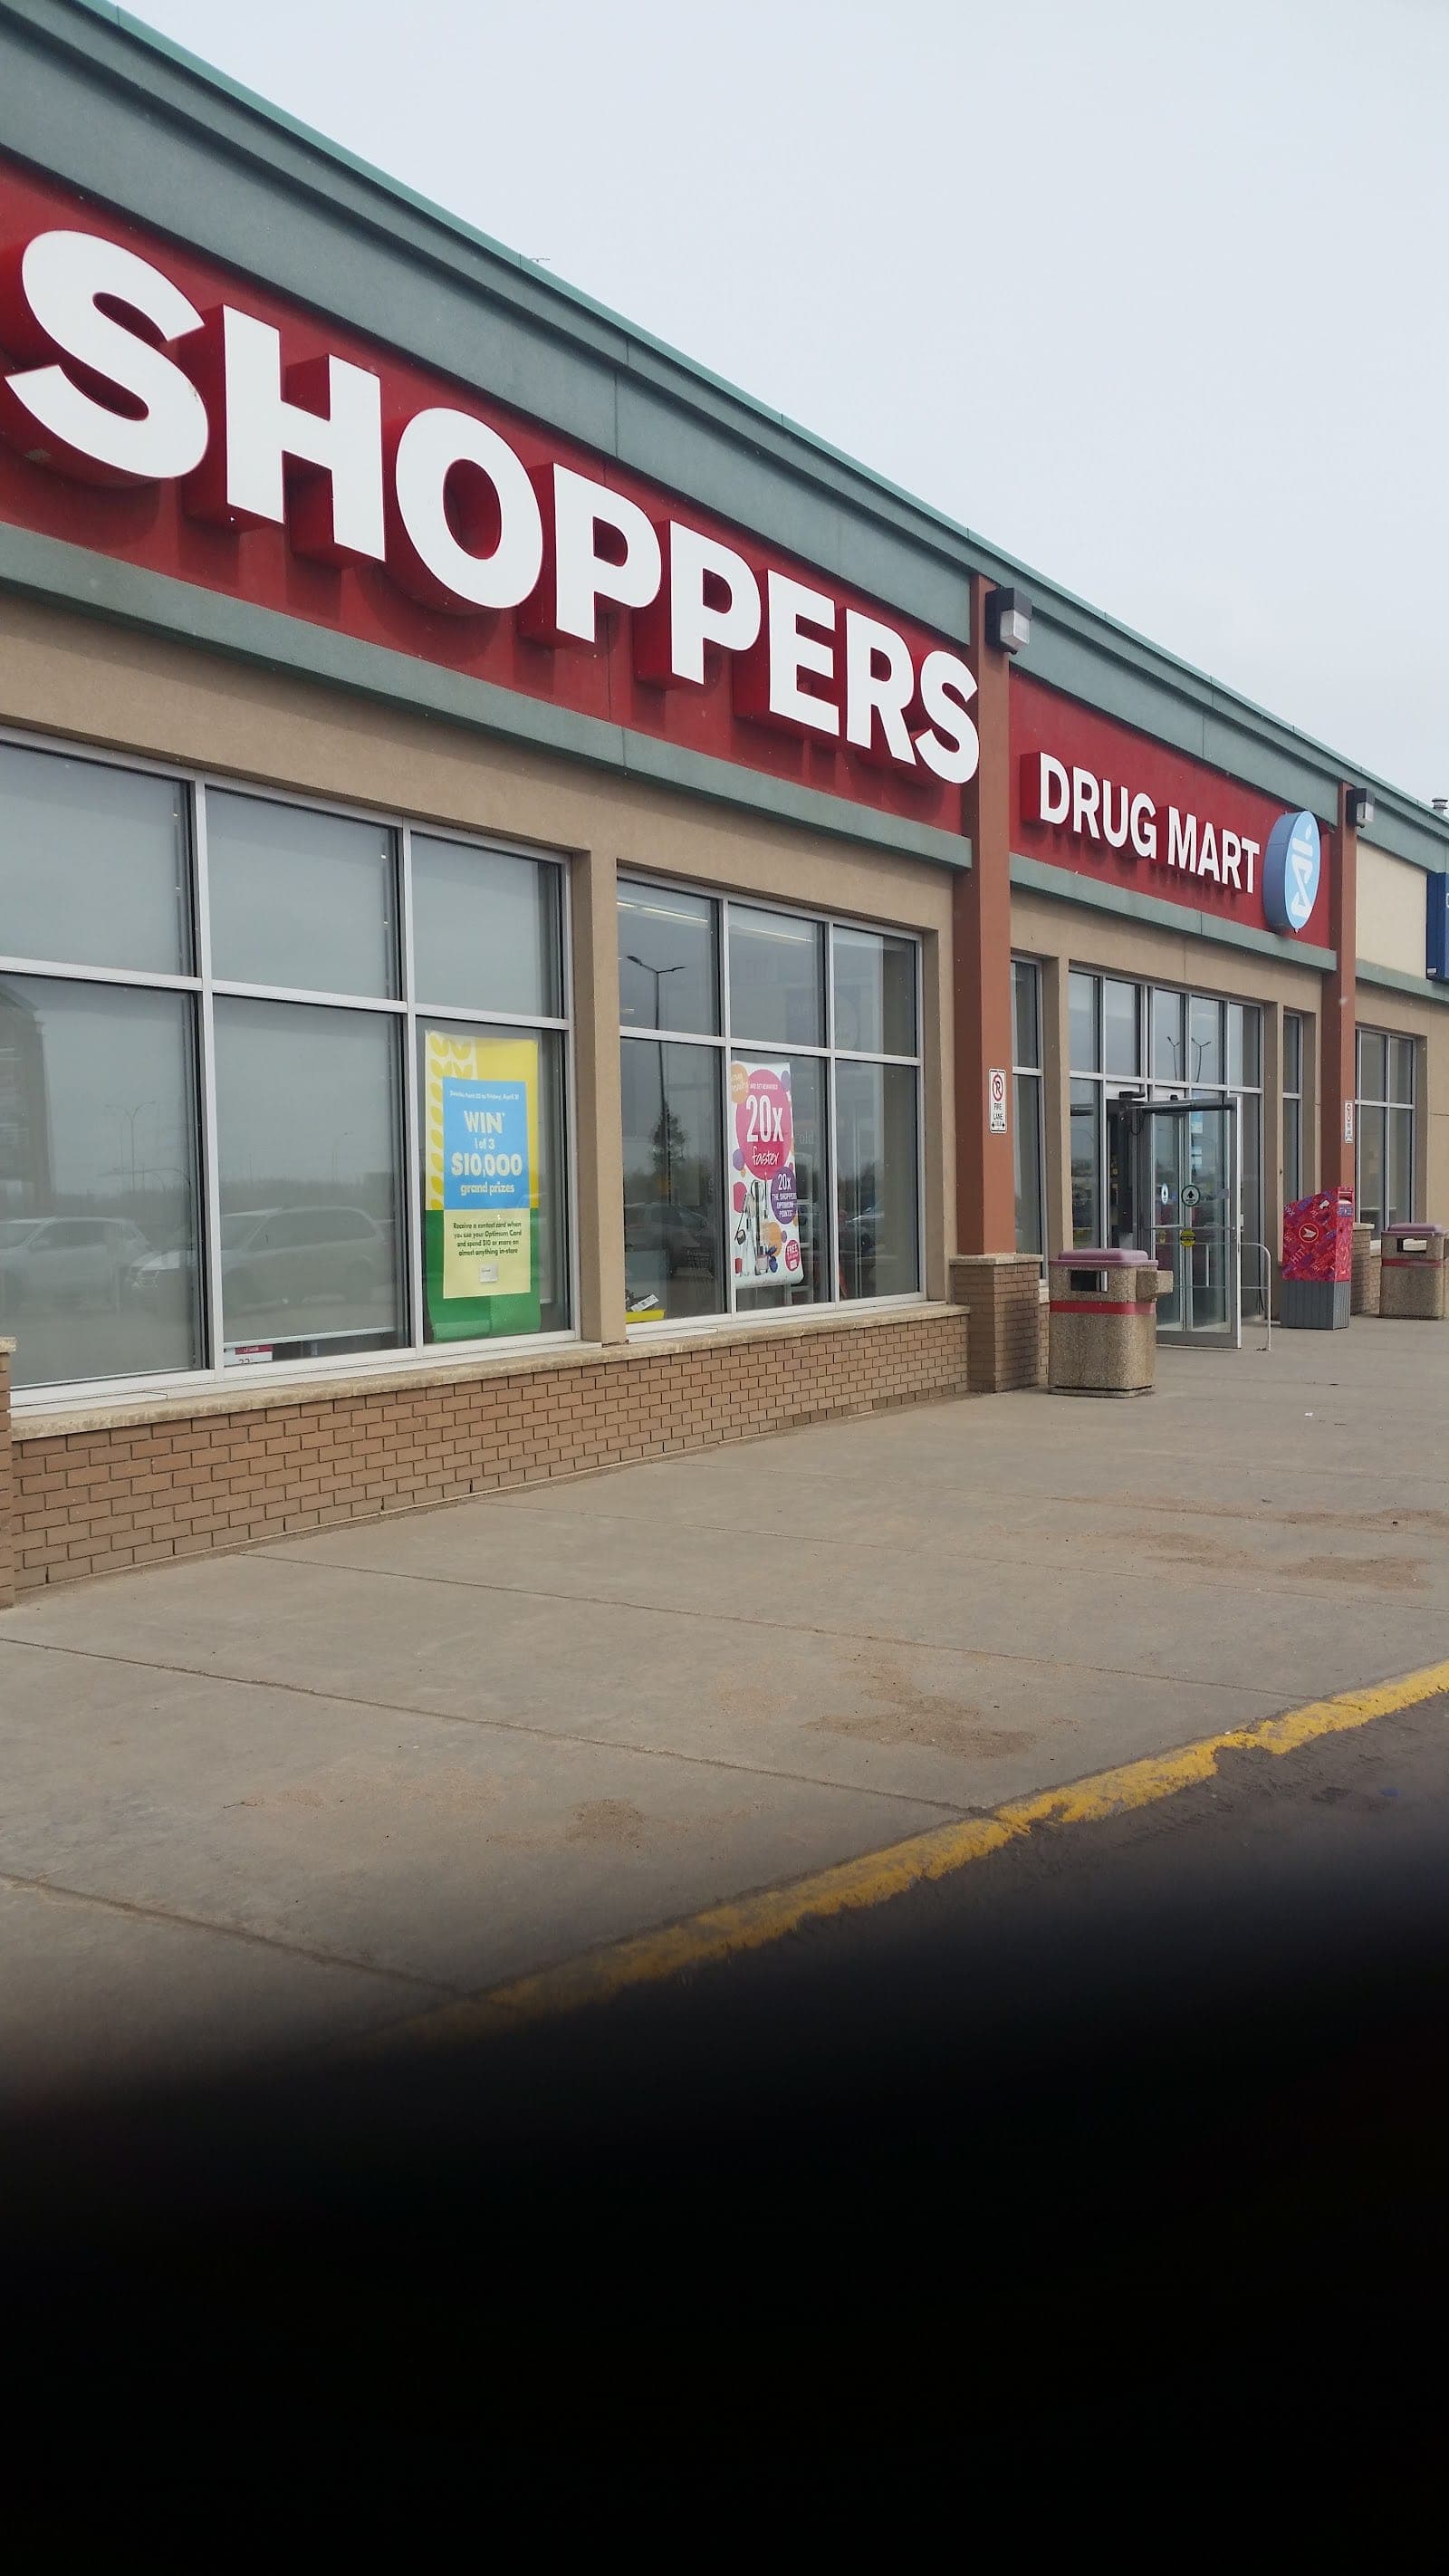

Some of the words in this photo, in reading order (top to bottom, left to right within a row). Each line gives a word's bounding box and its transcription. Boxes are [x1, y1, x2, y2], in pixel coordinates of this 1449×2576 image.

[5, 230, 979, 784] SHOPPERS
[1040, 752, 1157, 859] DRUG
[1167, 806, 1260, 894] MART
[745, 1094, 784, 1142] 20x
[479, 1138, 486, 1149] of
[488, 1139, 495, 1149] 3
[451, 1152, 523, 1177] $10,000
[752, 1145, 780, 1166] faster
[461, 1181, 488, 1196] grand
[490, 1181, 514, 1196] prizes
[778, 1173, 792, 1190] 20x
[475, 1248, 498, 1256] anything
[787, 1244, 798, 1256] FREE
